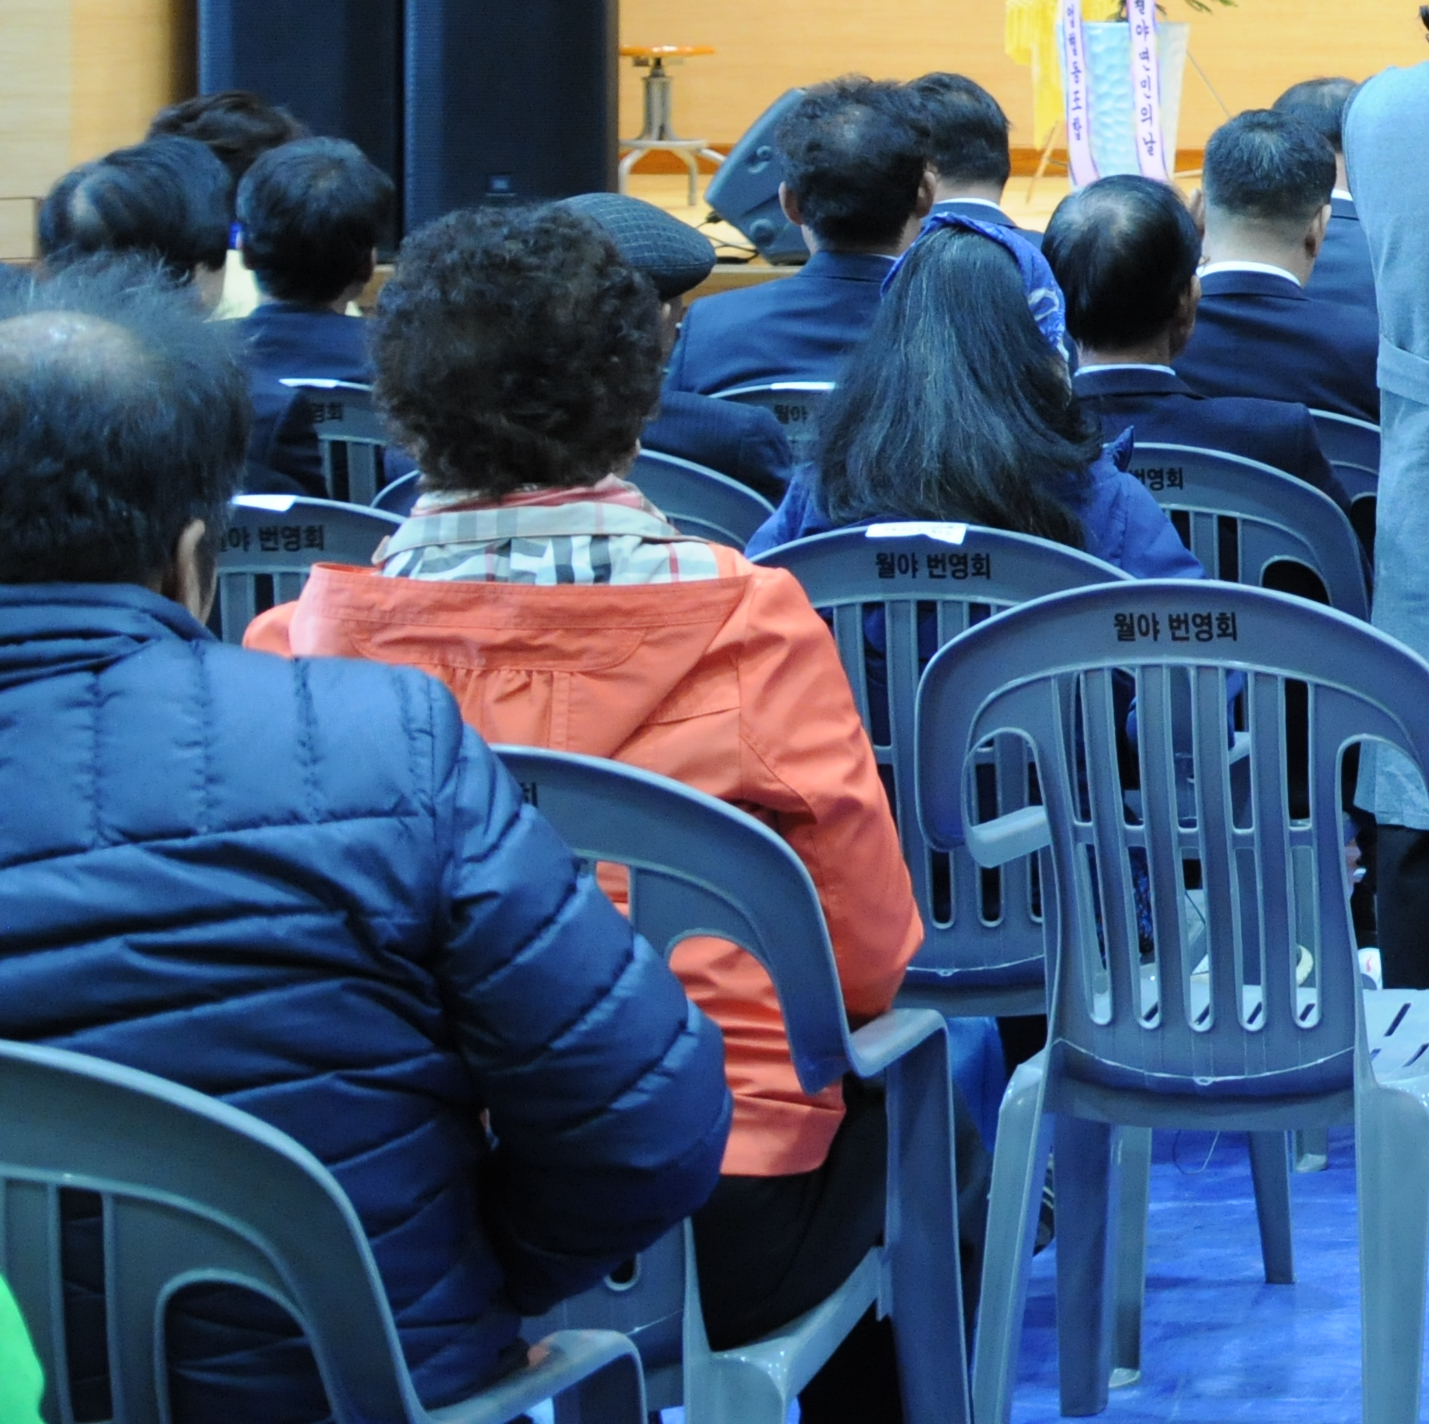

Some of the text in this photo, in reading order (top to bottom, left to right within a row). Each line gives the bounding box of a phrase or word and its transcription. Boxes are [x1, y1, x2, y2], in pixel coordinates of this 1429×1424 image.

[258, 525, 324, 552] 번영회
[876, 552, 991, 580] 월야 번영회
[1114, 612, 1238, 642] 월야 번영회
